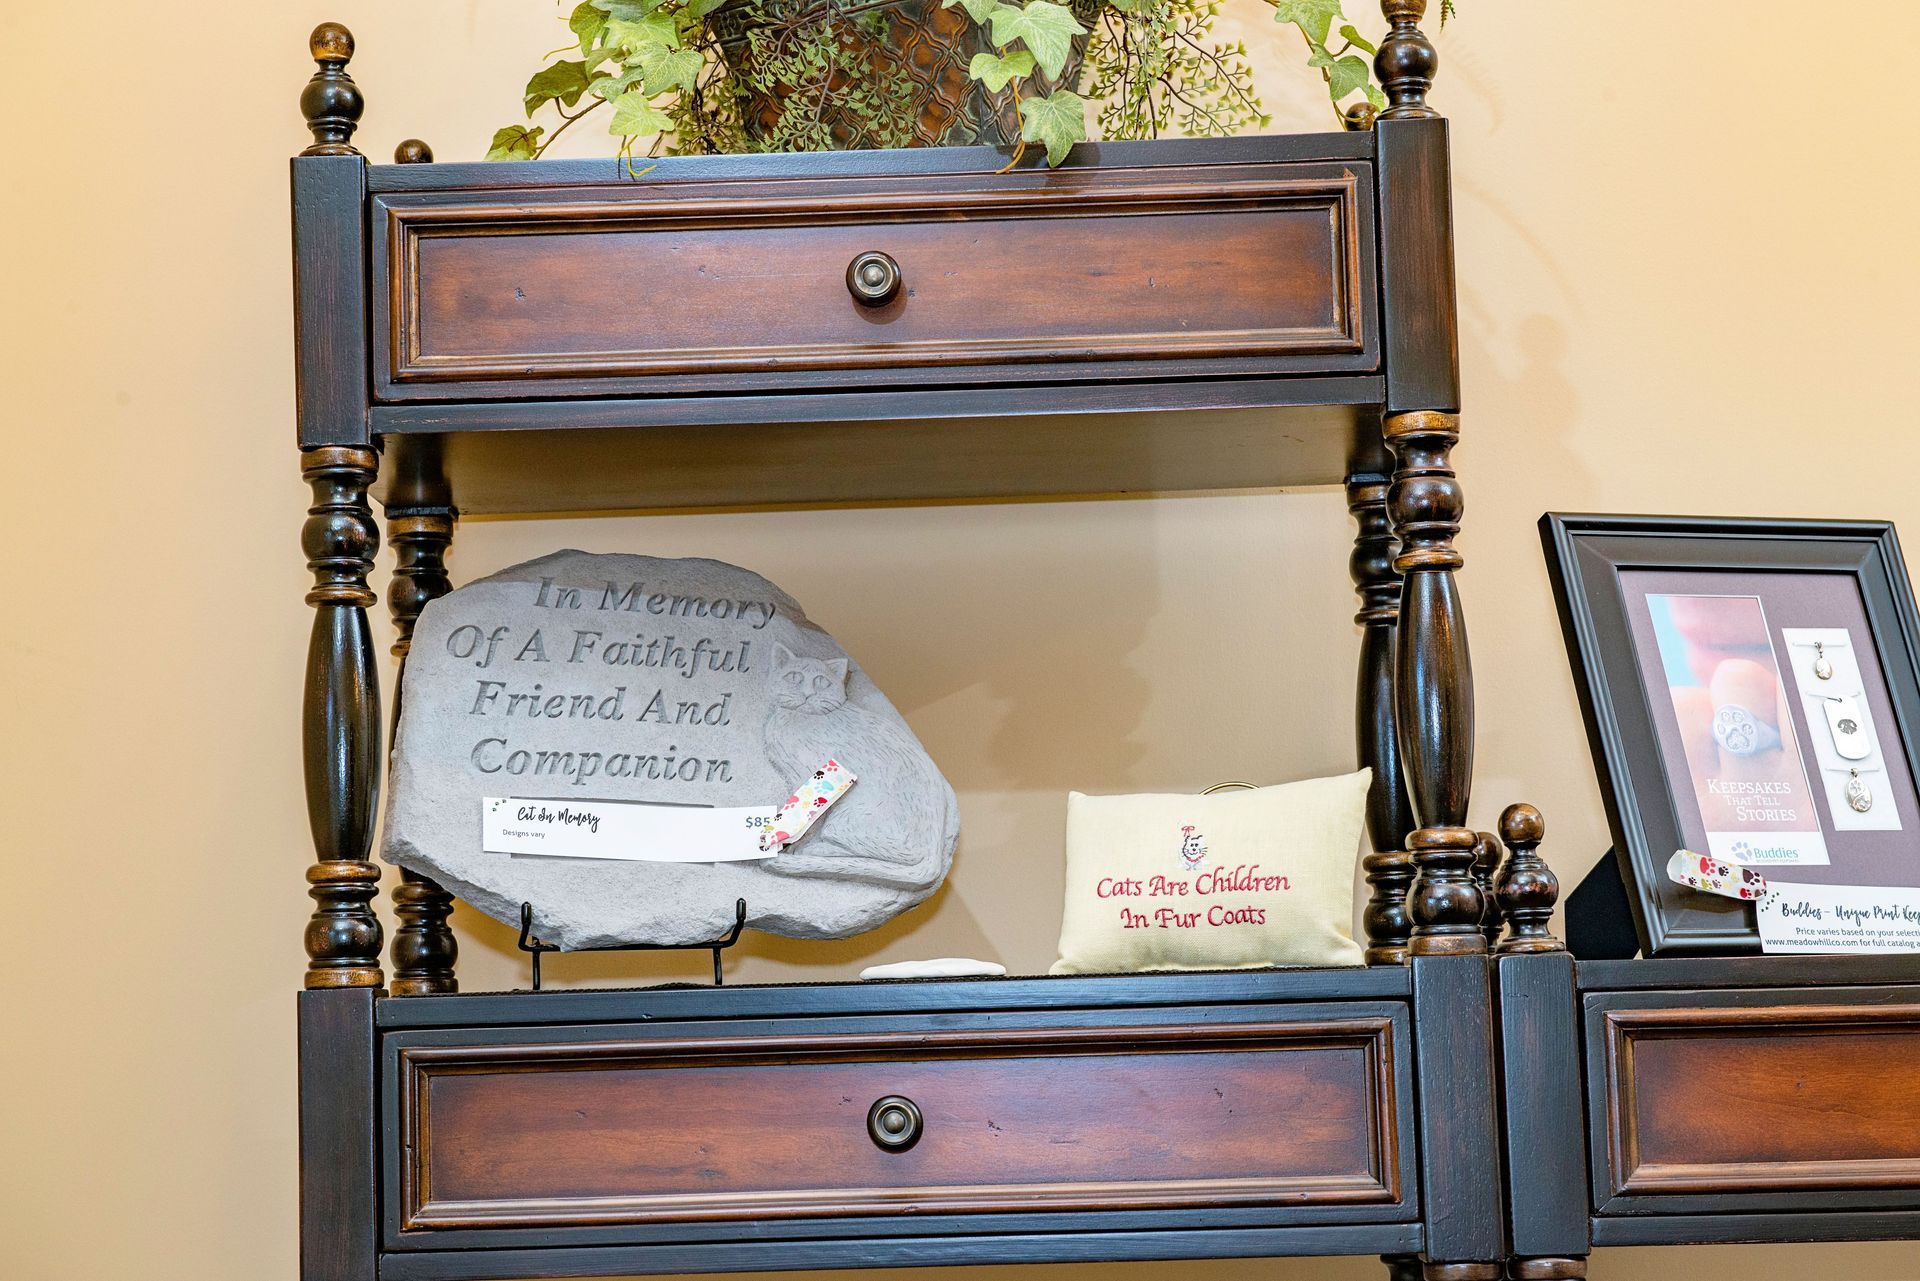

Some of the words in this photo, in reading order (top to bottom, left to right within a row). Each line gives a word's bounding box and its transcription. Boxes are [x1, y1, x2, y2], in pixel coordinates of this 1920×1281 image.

[533, 576, 582, 610] In
[598, 581, 776, 629] Memory
[447, 625, 510, 668] Of
[514, 629, 550, 662] A
[567, 630, 751, 678] Faithful
[469, 680, 627, 721] Friend
[635, 687, 732, 726] And
[470, 738, 733, 786] Companion
[517, 806, 536, 821] Cat
[538, 808, 555, 823] In
[558, 808, 600, 833] Memory
[503, 829, 529, 838] Designs
[1753, 847, 1799, 859] Buddies
[1097, 877, 1142, 898] Cats
[1149, 875, 1189, 897] Are
[1196, 864, 1290, 895] Children
[1120, 908, 1150, 929] In
[1155, 908, 1201, 929] Fur
[1208, 905, 1266, 926] Coats
[1782, 901, 1822, 920] Buddies
[1836, 905, 1871, 927] Unique
[1873, 905, 1901, 920] Print
[1766, 939, 1859, 947] www.meadowhillco.com
[1860, 939, 1871, 947] for
[1872, 939, 1886, 947] full
[1888, 939, 1915, 948] catalog
[1796, 928, 1815, 936] Price
[1817, 928, 1840, 936] varies
[1842, 928, 1864, 936] based
